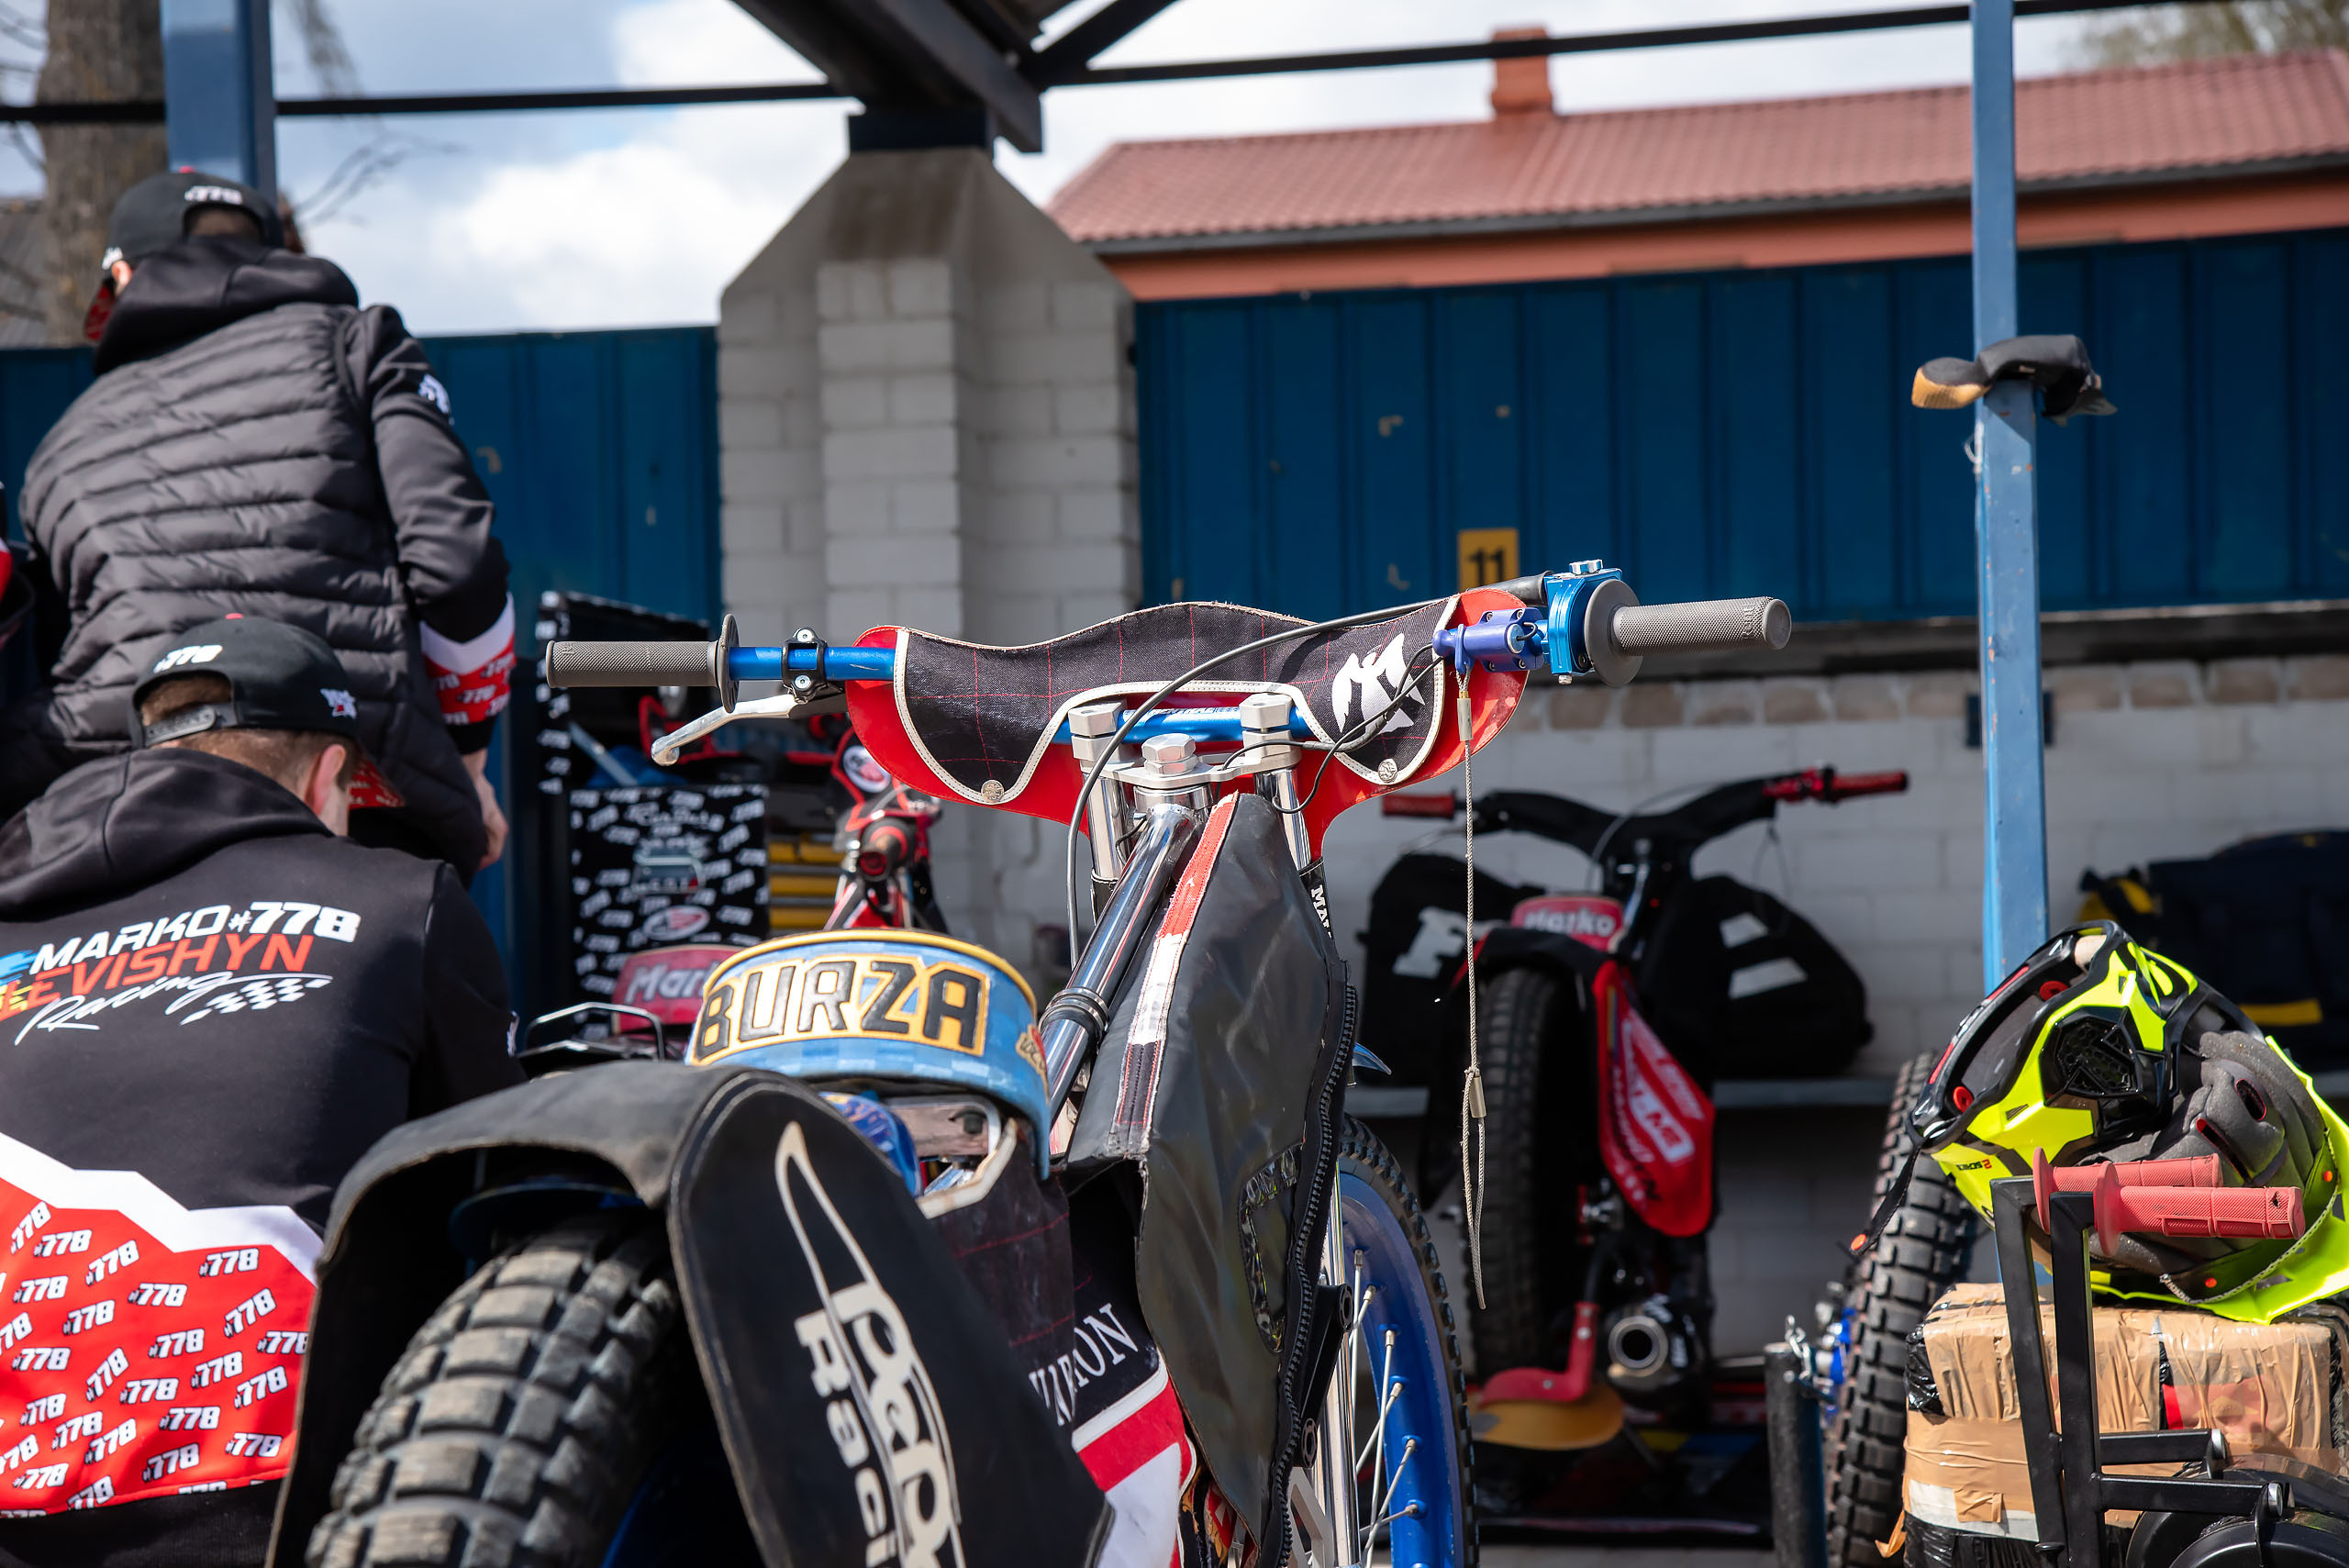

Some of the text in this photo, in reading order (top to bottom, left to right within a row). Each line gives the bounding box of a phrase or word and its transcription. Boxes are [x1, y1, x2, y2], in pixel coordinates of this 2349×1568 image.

[15, 972, 240, 1045] Racing
[695, 960, 983, 1061] BURZA
[0, 1312, 33, 1355] 78
[795, 1309, 899, 1568] Raci
